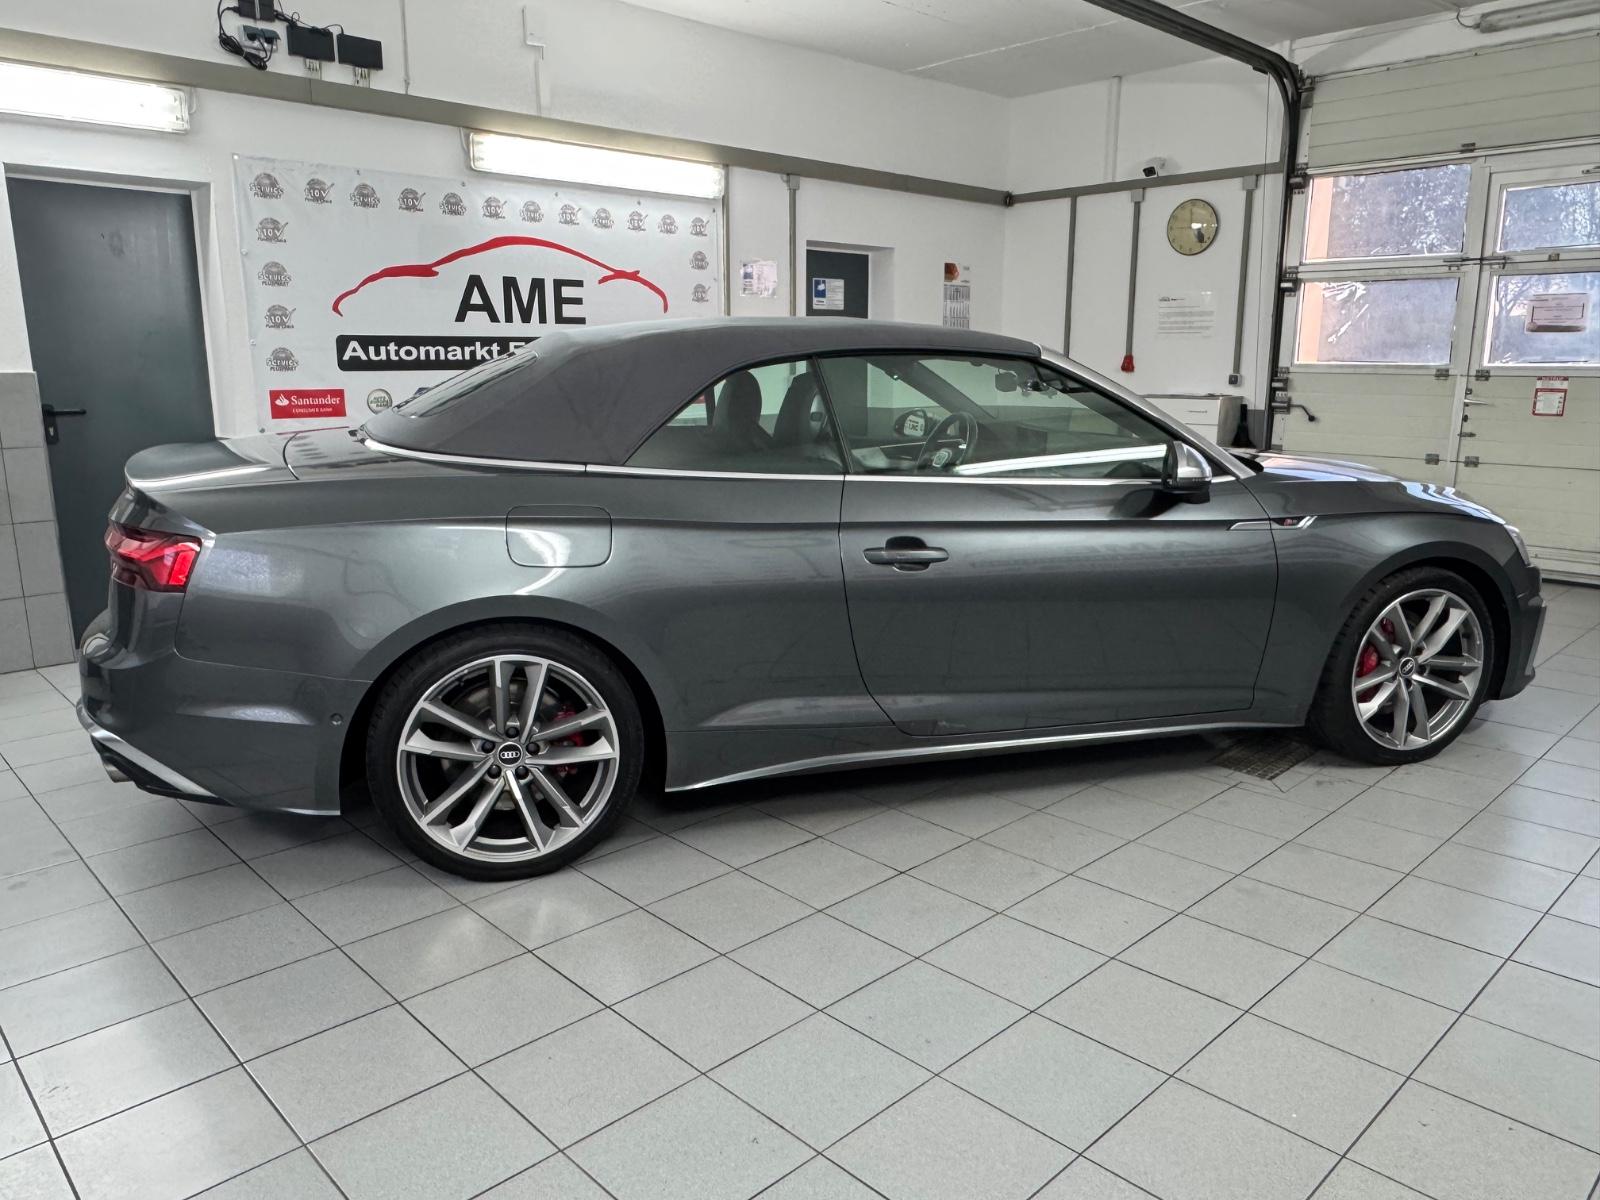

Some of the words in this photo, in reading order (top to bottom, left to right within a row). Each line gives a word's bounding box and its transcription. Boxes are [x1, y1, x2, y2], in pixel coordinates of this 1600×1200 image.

[454, 274, 586, 325] AME
[342, 341, 500, 361] Automarkt
[291, 394, 341, 405] Santander
